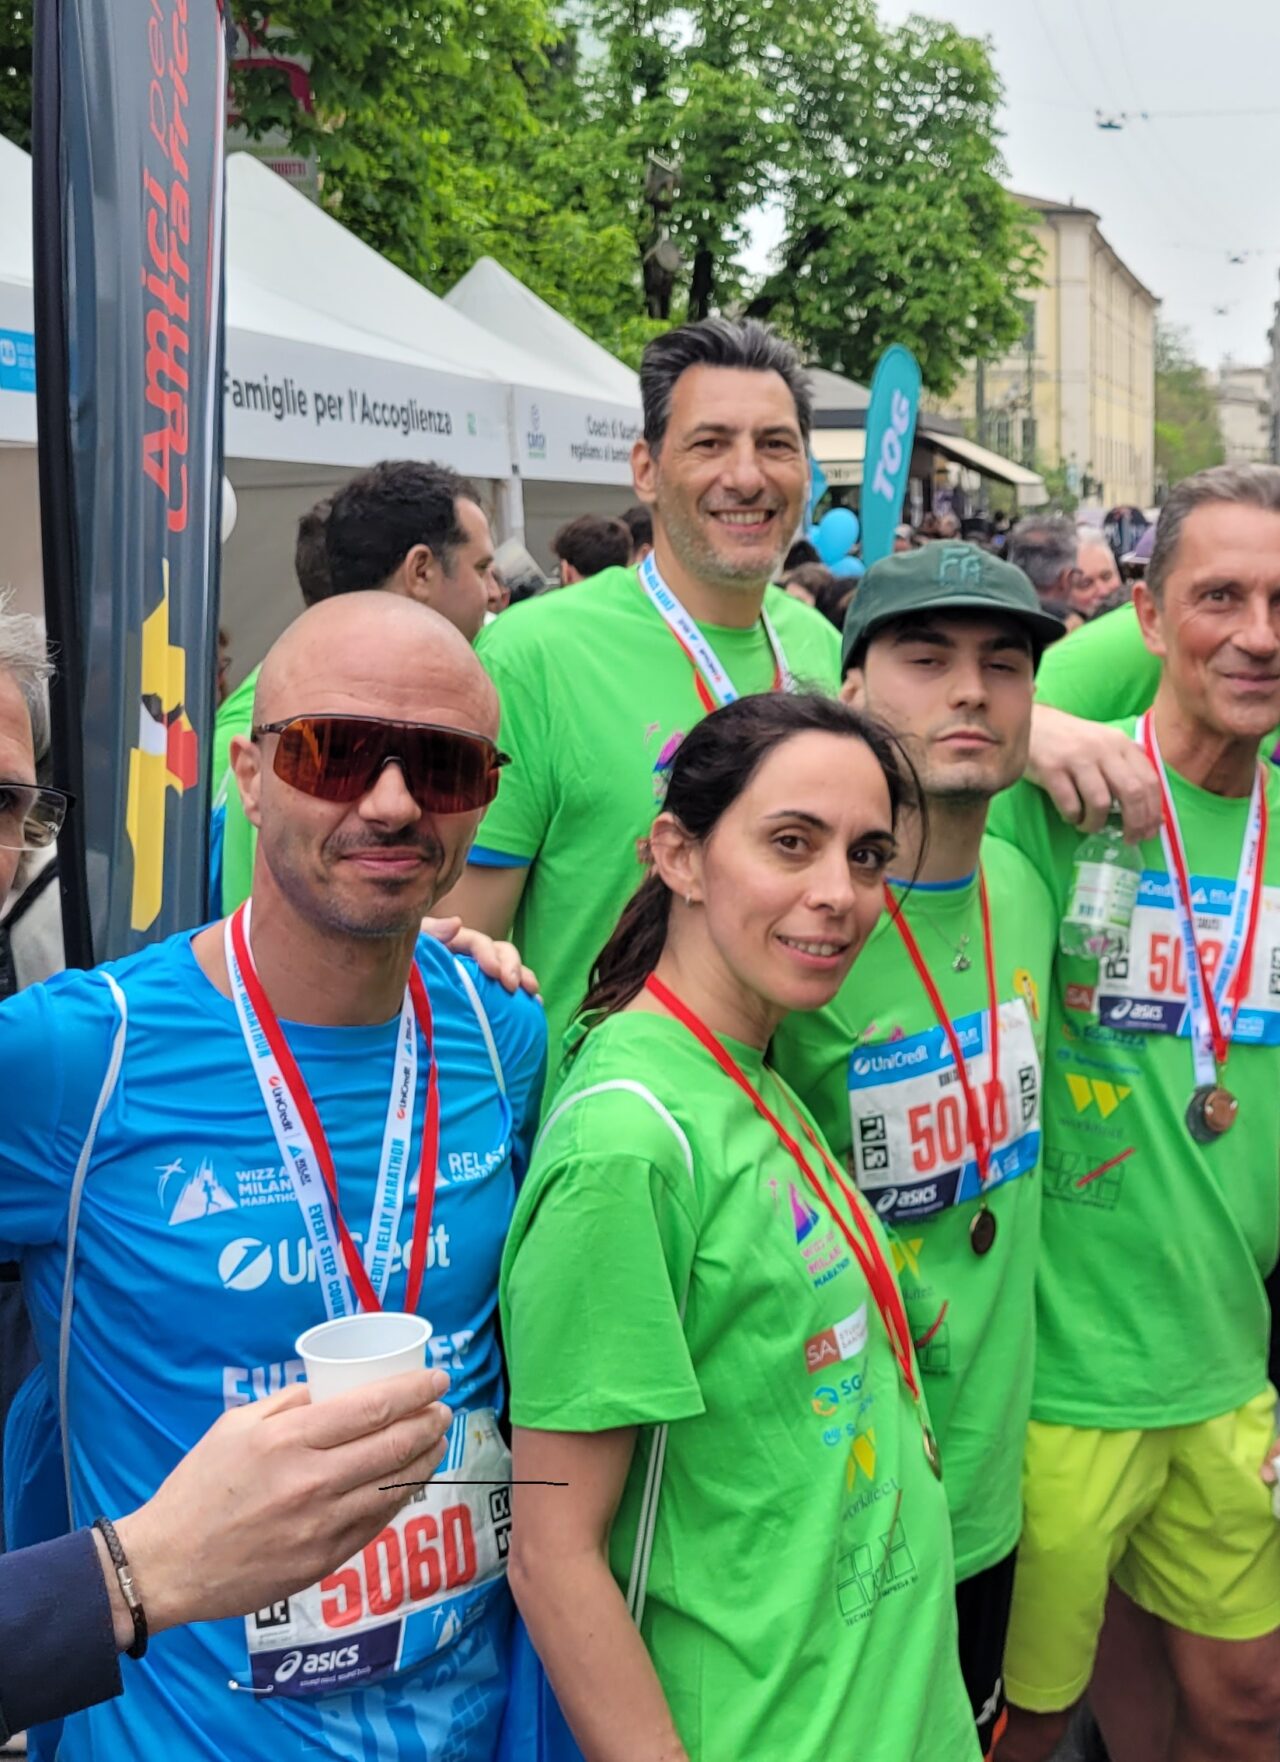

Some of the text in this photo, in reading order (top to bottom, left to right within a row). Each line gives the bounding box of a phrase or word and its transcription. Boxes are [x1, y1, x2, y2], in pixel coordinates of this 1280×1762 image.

[141, 167, 170, 498] Amici
[225, 370, 453, 437] amiglie per l'Accoglienza
[872, 388, 910, 502] TOG
[871, 1045, 928, 1073] UniCredit
[401, 1065, 411, 1109] UniCredit
[908, 1081, 1010, 1174] 500
[235, 1166, 276, 1184] WIZZ
[237, 1180, 294, 1200] MILAN
[272, 1085, 294, 1132] UniCredit
[308, 1202, 330, 1243] EVERY
[320, 1245, 339, 1277] STEP
[384, 1136, 406, 1210] MARATHON
[240, 1193, 298, 1208] MARATHO
[897, 1184, 938, 1207] asics
[376, 1211, 394, 1252] RELAY
[368, 1256, 388, 1298] REDIT
[807, 1339, 837, 1366] SA
[320, 1503, 478, 1630] 5060
[303, 1644, 360, 1674] asics
